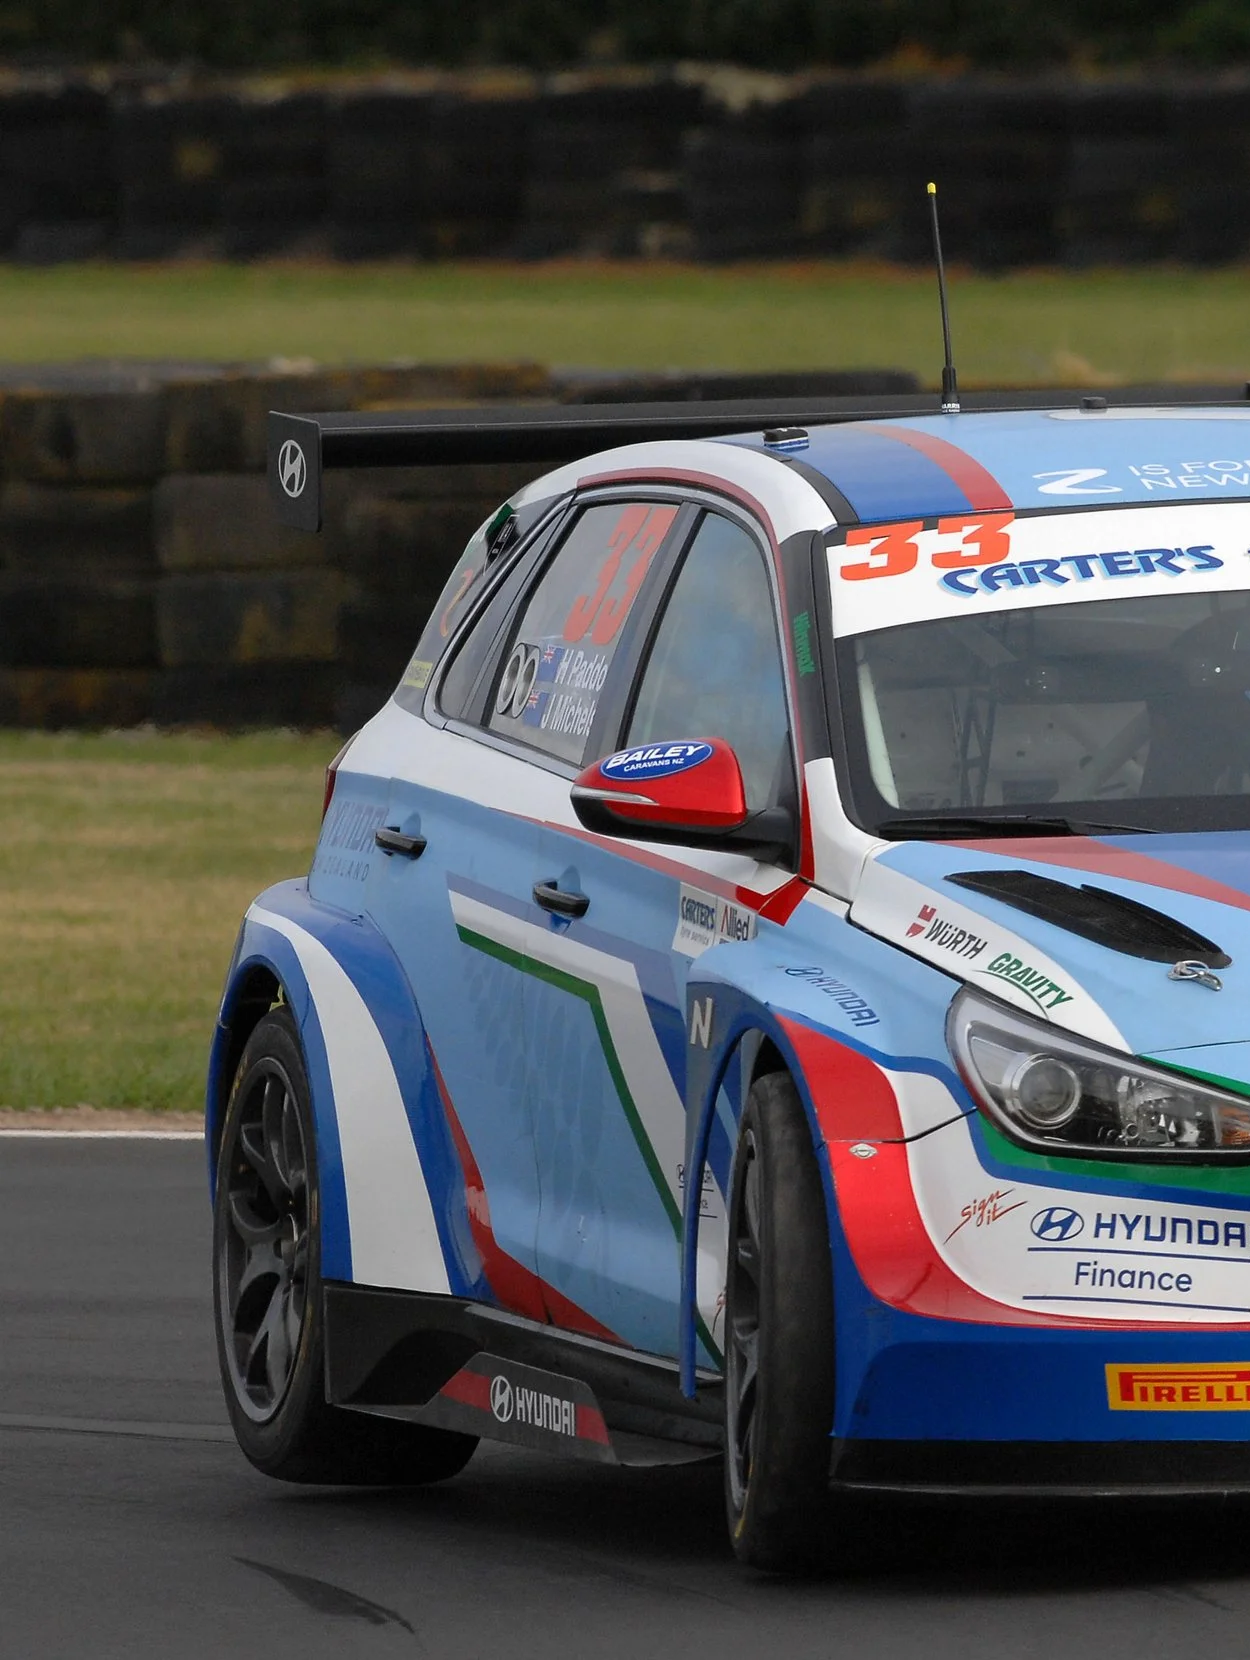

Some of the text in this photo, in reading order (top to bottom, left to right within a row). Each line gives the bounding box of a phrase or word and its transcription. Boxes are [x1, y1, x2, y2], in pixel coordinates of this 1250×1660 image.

[1127, 463, 1172, 477] IS
[1138, 473, 1250, 491] NEW
[839, 512, 1015, 582] 33
[562, 504, 679, 646] 33
[940, 544, 1224, 597] CARTER'S
[554, 648, 574, 686] H
[540, 692, 556, 730] J
[606, 745, 705, 769] BAILEY
[623, 757, 685, 772] CARAVANS NZ
[720, 904, 751, 942] Allied
[922, 917, 989, 960] WÜRTH
[986, 951, 1074, 1010] GRAVITY
[806, 975, 881, 1027] HYUNDAI
[689, 996, 714, 1049] N
[1074, 1261, 1193, 1293] Finance
[515, 1386, 577, 1437] HYUNDAI
